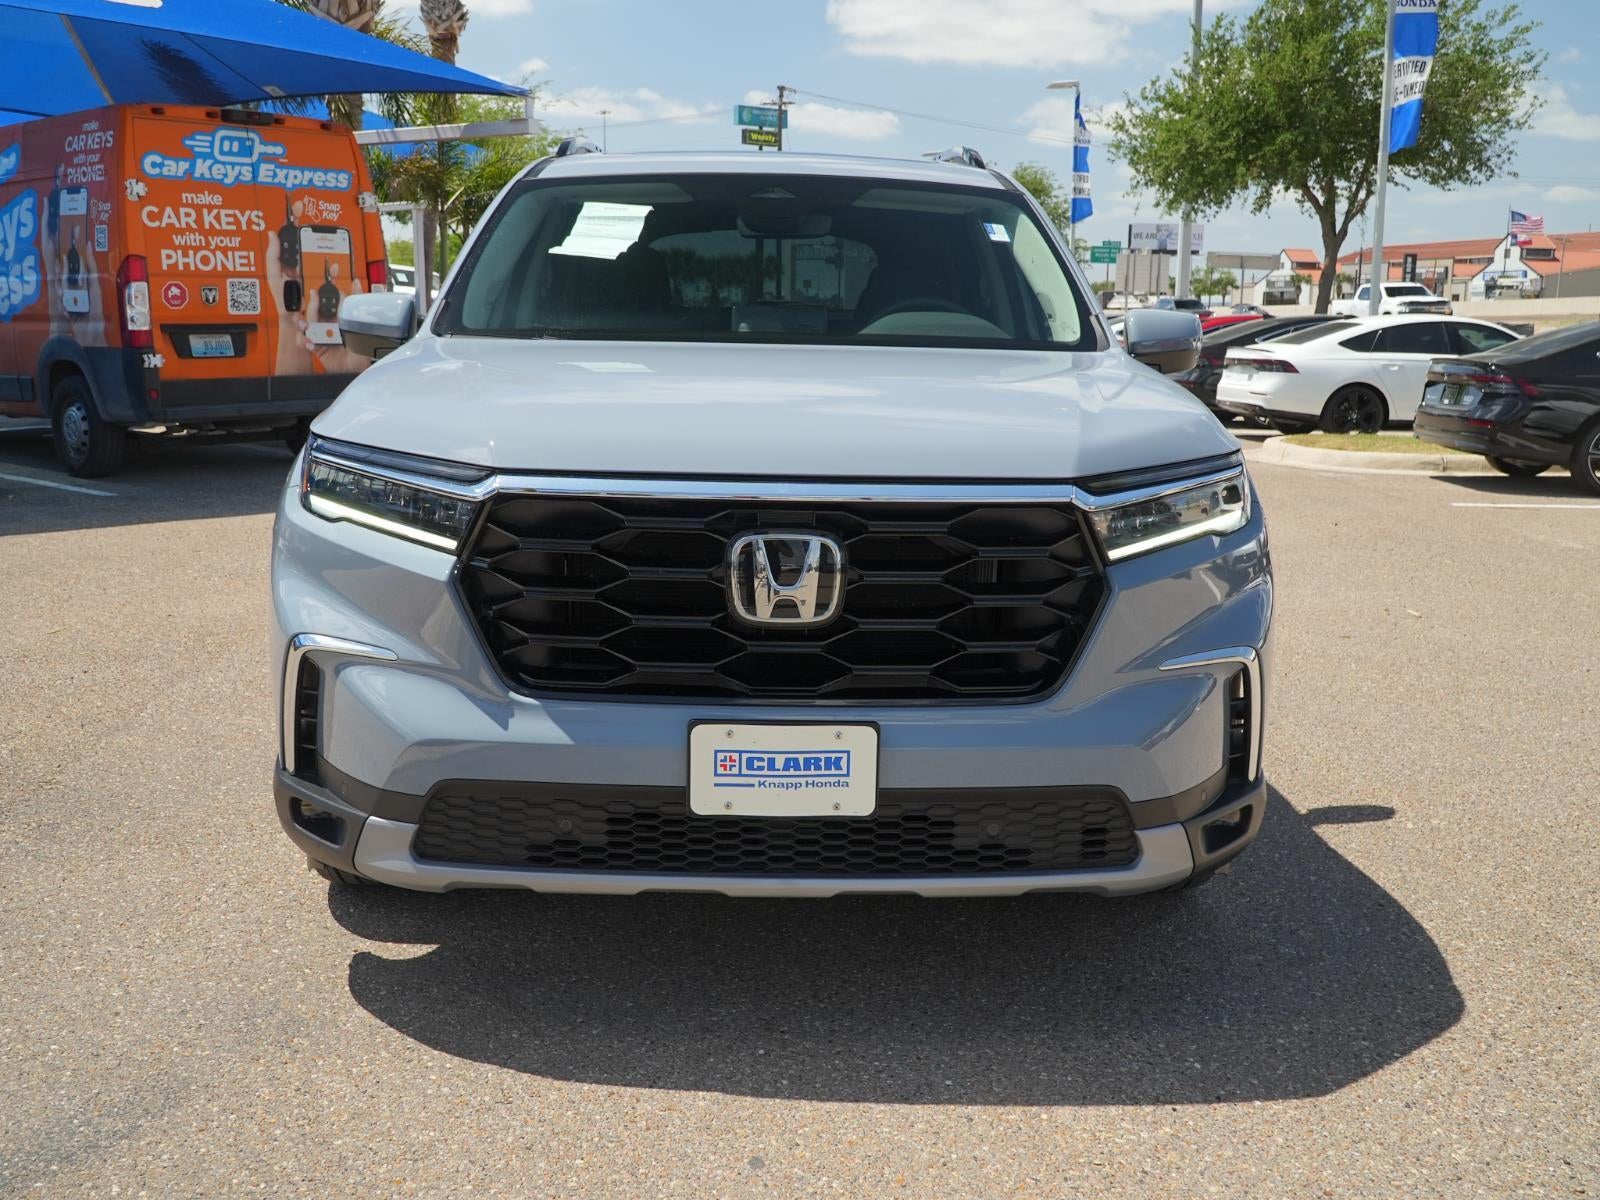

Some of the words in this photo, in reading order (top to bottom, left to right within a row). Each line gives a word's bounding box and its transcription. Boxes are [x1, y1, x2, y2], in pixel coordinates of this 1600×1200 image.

[65, 134, 87, 152] CAR
[87, 130, 114, 149] KEYS
[143, 154, 190, 177] Car
[194, 158, 253, 184] Keys
[258, 163, 350, 189] Express
[182, 190, 223, 205] make
[318, 200, 341, 211] Snap
[141, 205, 198, 229] CAR
[202, 208, 266, 231] KEYS
[172, 232, 206, 247] with
[208, 236, 241, 249] your
[1133, 231, 1143, 240] WE
[161, 249, 256, 272] PHONE!
[745, 756, 844, 772] CLARK
[758, 780, 803, 790] Knapp
[805, 780, 849, 789] Honda
